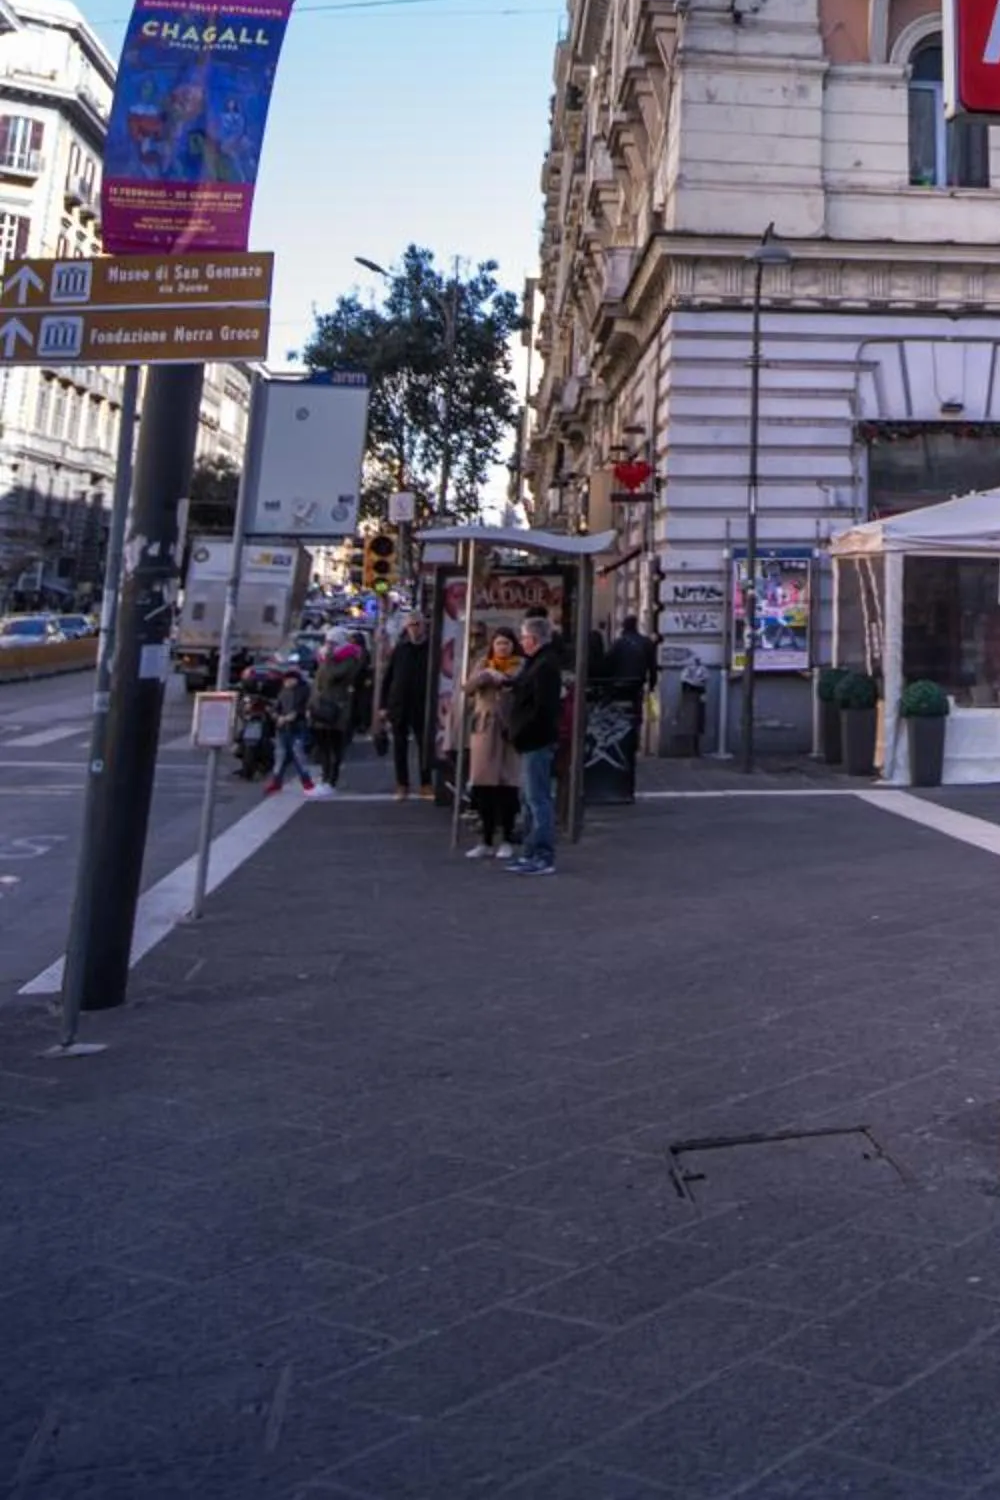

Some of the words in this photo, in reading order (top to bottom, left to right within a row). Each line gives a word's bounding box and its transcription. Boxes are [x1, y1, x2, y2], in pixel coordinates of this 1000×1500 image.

[142, 21, 269, 46] CHAGALL
[108, 265, 149, 282] Museo
[155, 264, 168, 281] di
[174, 263, 199, 280] San
[205, 263, 263, 279] Gennaro
[90, 327, 167, 345] Fondazione
[332, 371, 368, 385] anm
